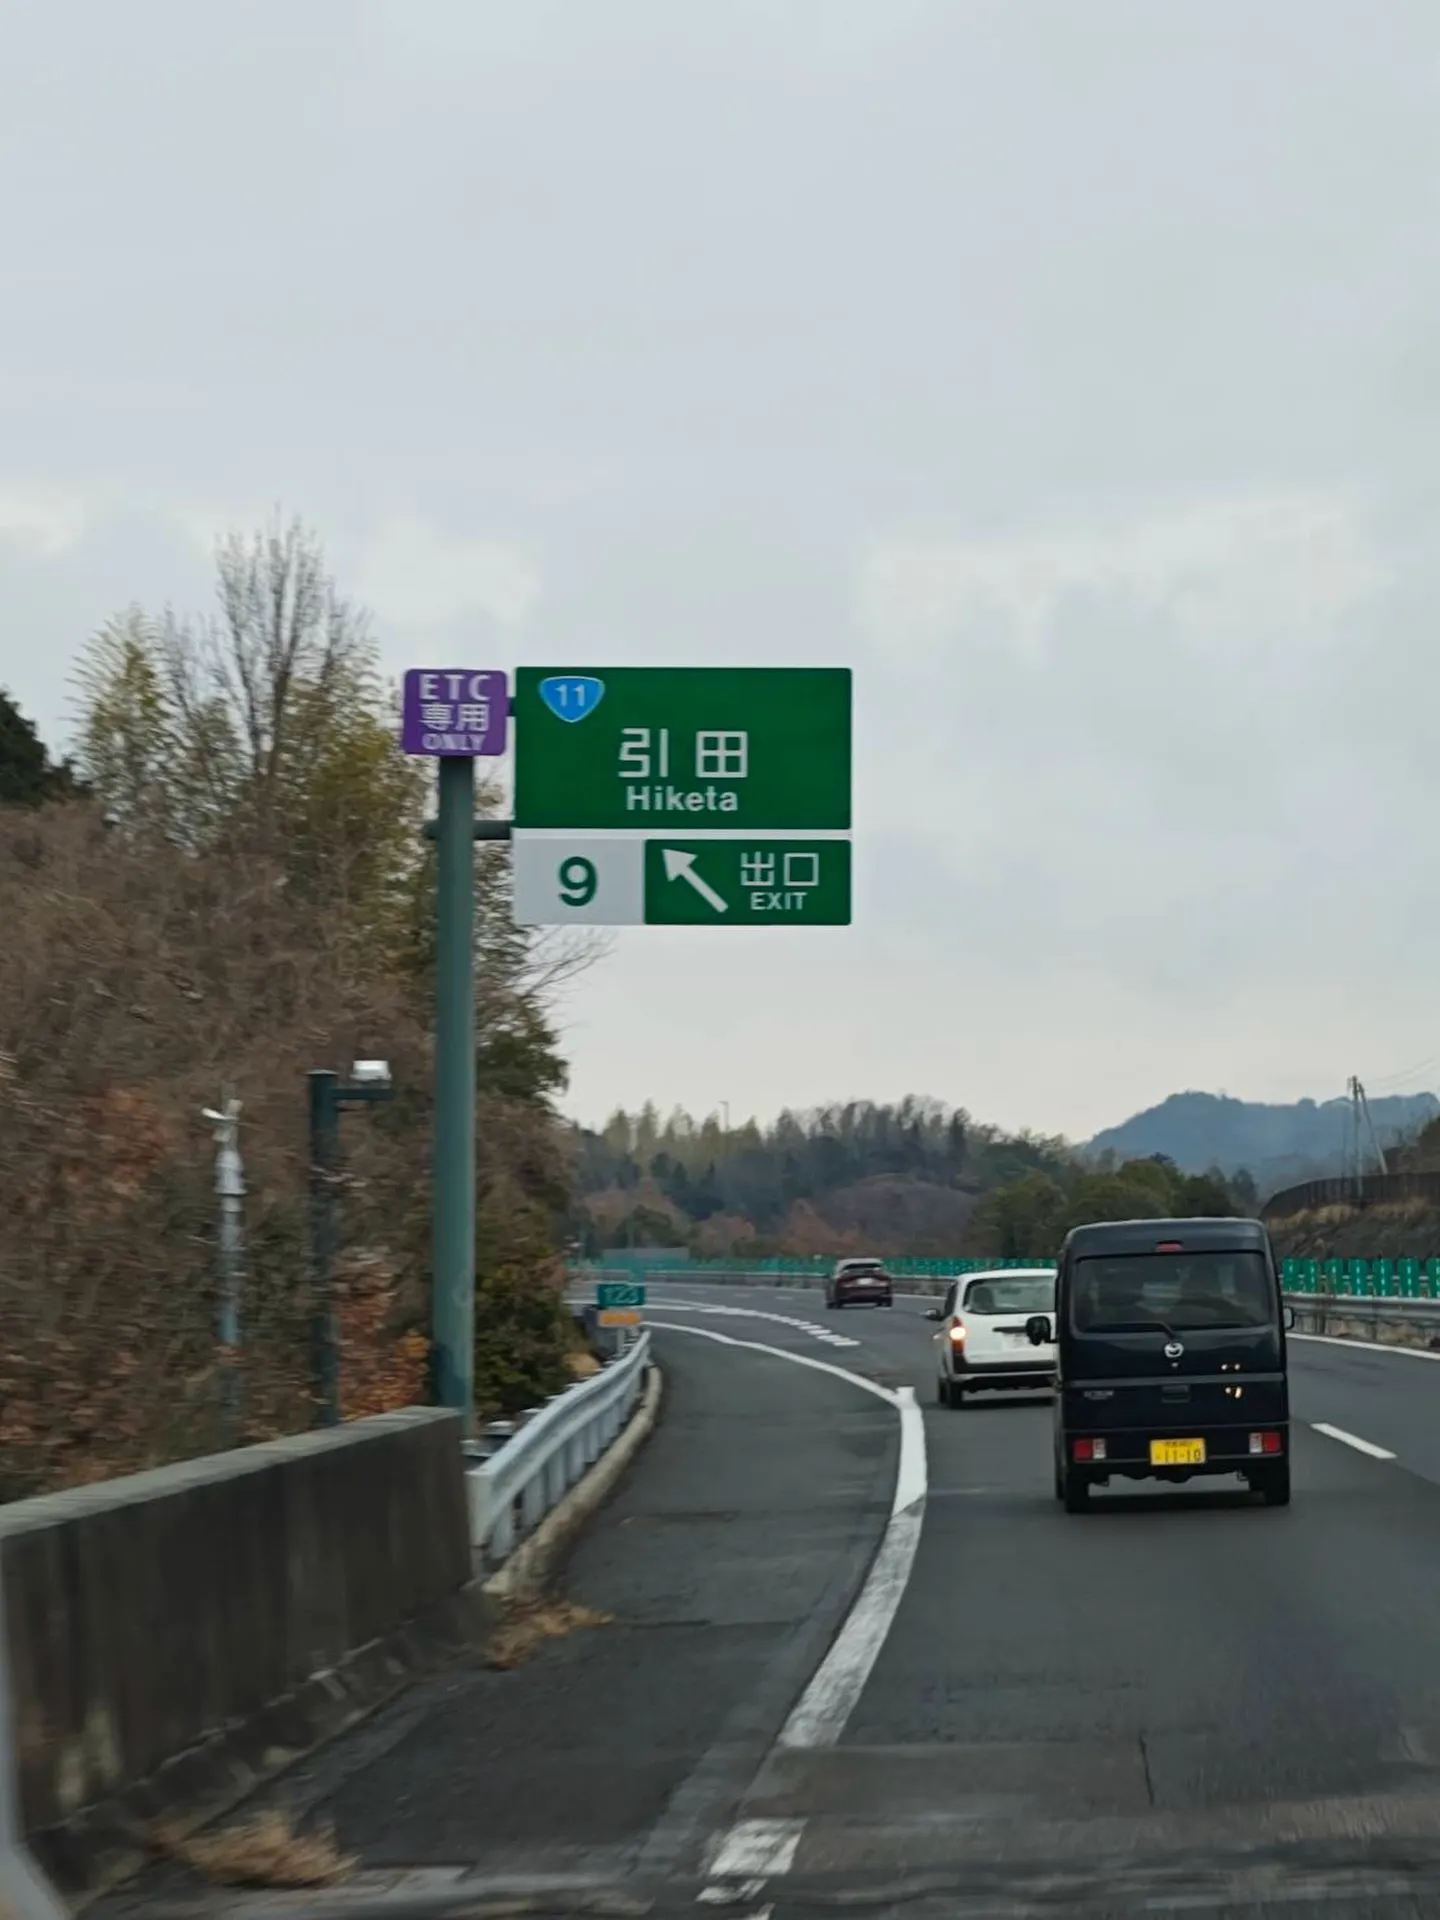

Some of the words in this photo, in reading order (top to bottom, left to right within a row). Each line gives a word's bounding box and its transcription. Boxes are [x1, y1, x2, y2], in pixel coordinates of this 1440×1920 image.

[419, 674, 492, 701] ETC
[555, 684, 586, 707] 11
[419, 702, 490, 731] 専用
[422, 733, 487, 751] ONLY
[618, 728, 748, 778] 引田
[626, 786, 738, 812] Hiketa
[558, 856, 598, 907] 9
[740, 851, 819, 886] 出口
[750, 892, 808, 910] EXIT
